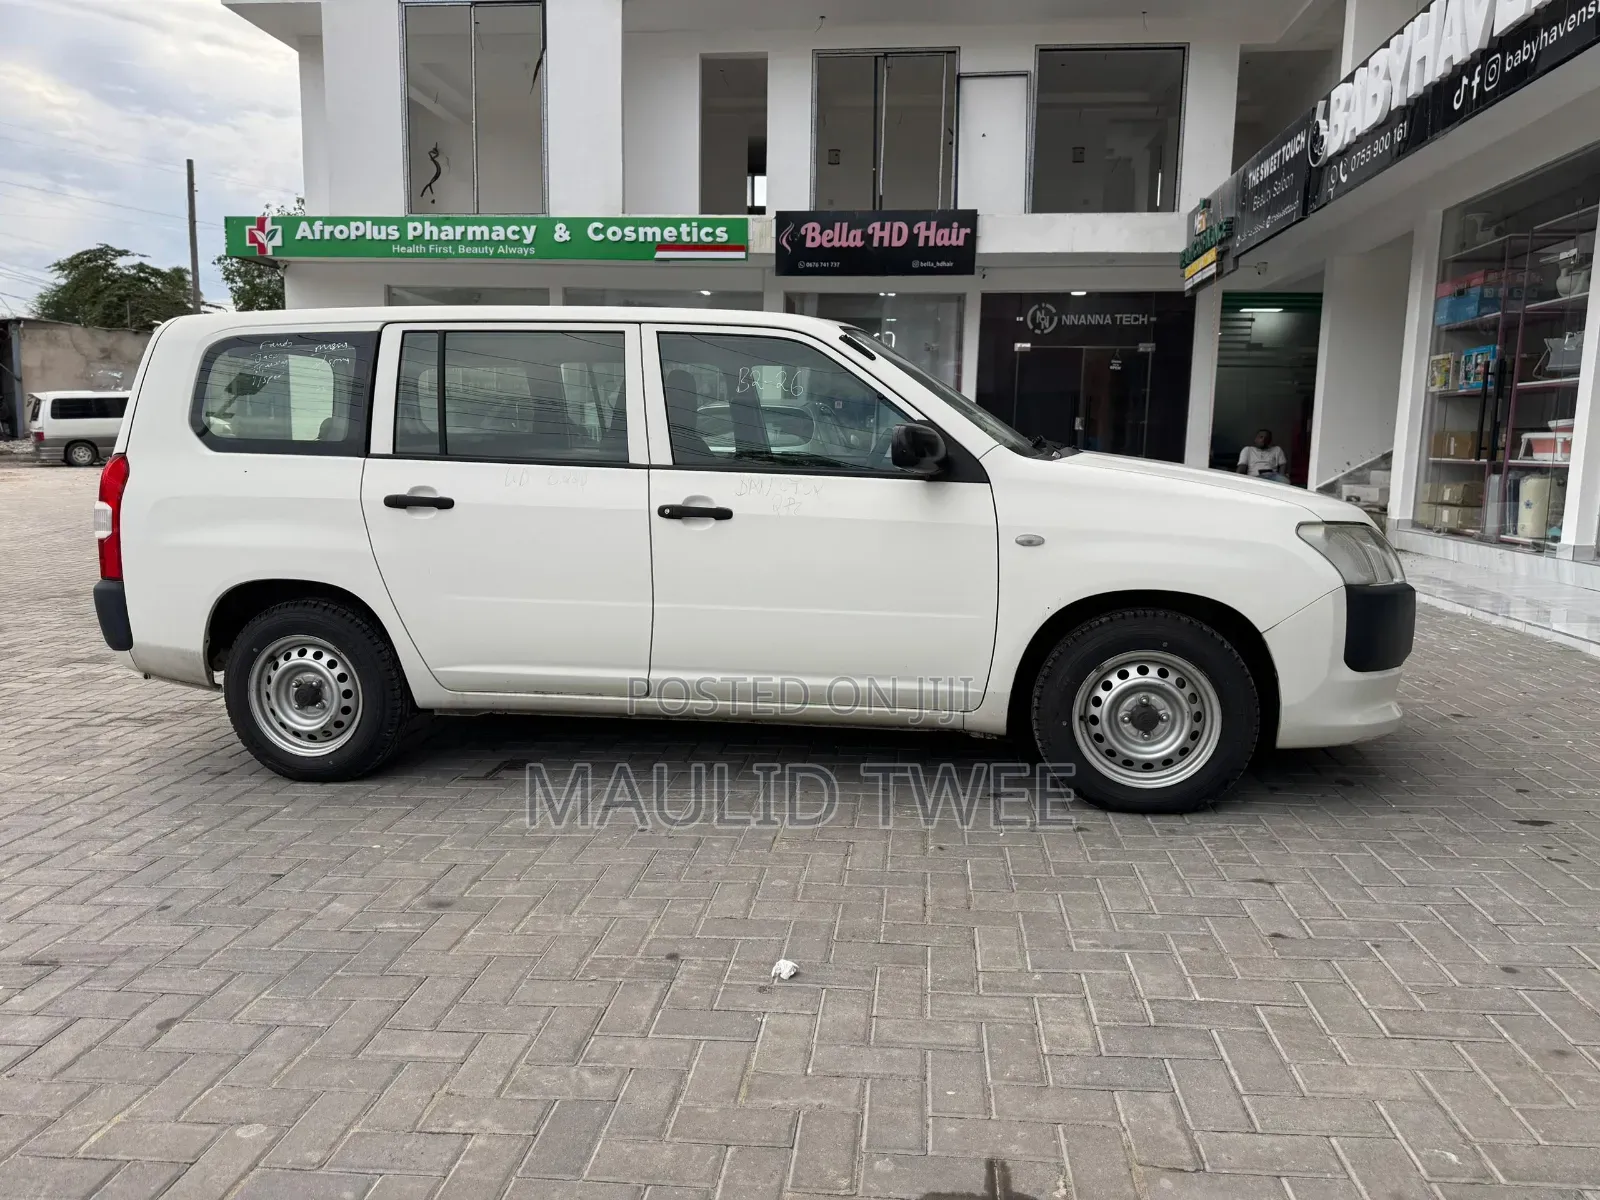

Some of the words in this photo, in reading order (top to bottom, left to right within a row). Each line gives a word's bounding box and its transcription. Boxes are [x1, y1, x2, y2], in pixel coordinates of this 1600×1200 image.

[1505, 0, 1600, 73] babyhavens
[1327, 0, 1552, 159] BABYHAV
[1248, 166, 1259, 190] THE
[1260, 149, 1281, 181] SWEET
[1281, 129, 1306, 165] TOUCH
[1350, 144, 1371, 172] 0755
[1373, 131, 1391, 158] 900
[1393, 120, 1408, 145] 161
[295, 220, 400, 241] AfroPlus
[407, 221, 537, 244] Pharmacy
[554, 222, 571, 243] &
[587, 222, 729, 243] Cosmetics
[392, 244, 426, 254] Health
[429, 244, 455, 255] First,
[458, 244, 494, 255] Beauty
[497, 244, 536, 255] Always
[800, 221, 865, 248] Bella
[867, 221, 909, 248] HD
[913, 220, 971, 247] Hair
[1061, 314, 1112, 325] NNANNA
[1115, 314, 1148, 325] TECH
